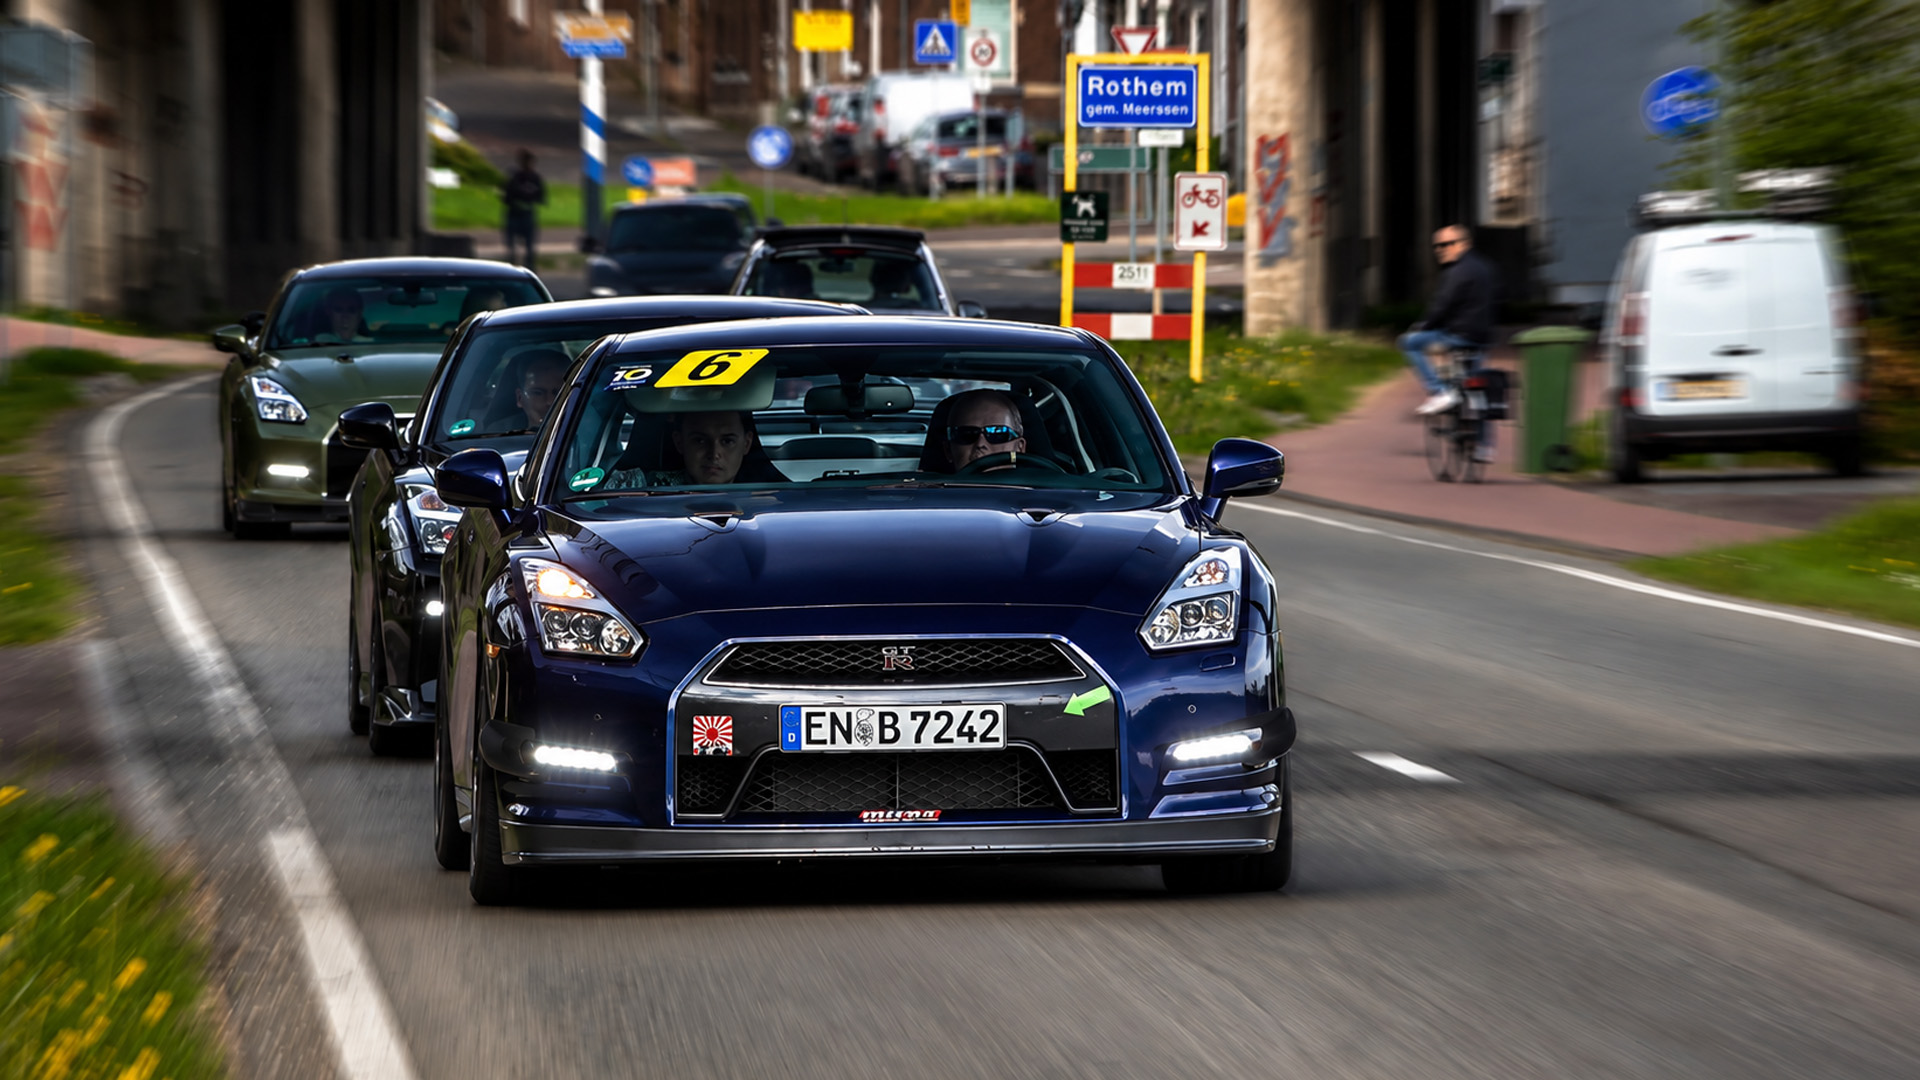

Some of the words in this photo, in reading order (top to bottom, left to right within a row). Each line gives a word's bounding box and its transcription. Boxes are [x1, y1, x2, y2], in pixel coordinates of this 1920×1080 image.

[1087, 75, 1187, 96] Rothem
[1086, 104, 1119, 118] gem.
[1122, 103, 1189, 116] Meerssen
[613, 368, 653, 382] 10
[687, 351, 742, 381] 6
[805, 711, 853, 745] EN
[878, 711, 901, 745] B
[910, 709, 1000, 744] 7242
[787, 732, 797, 743] D
